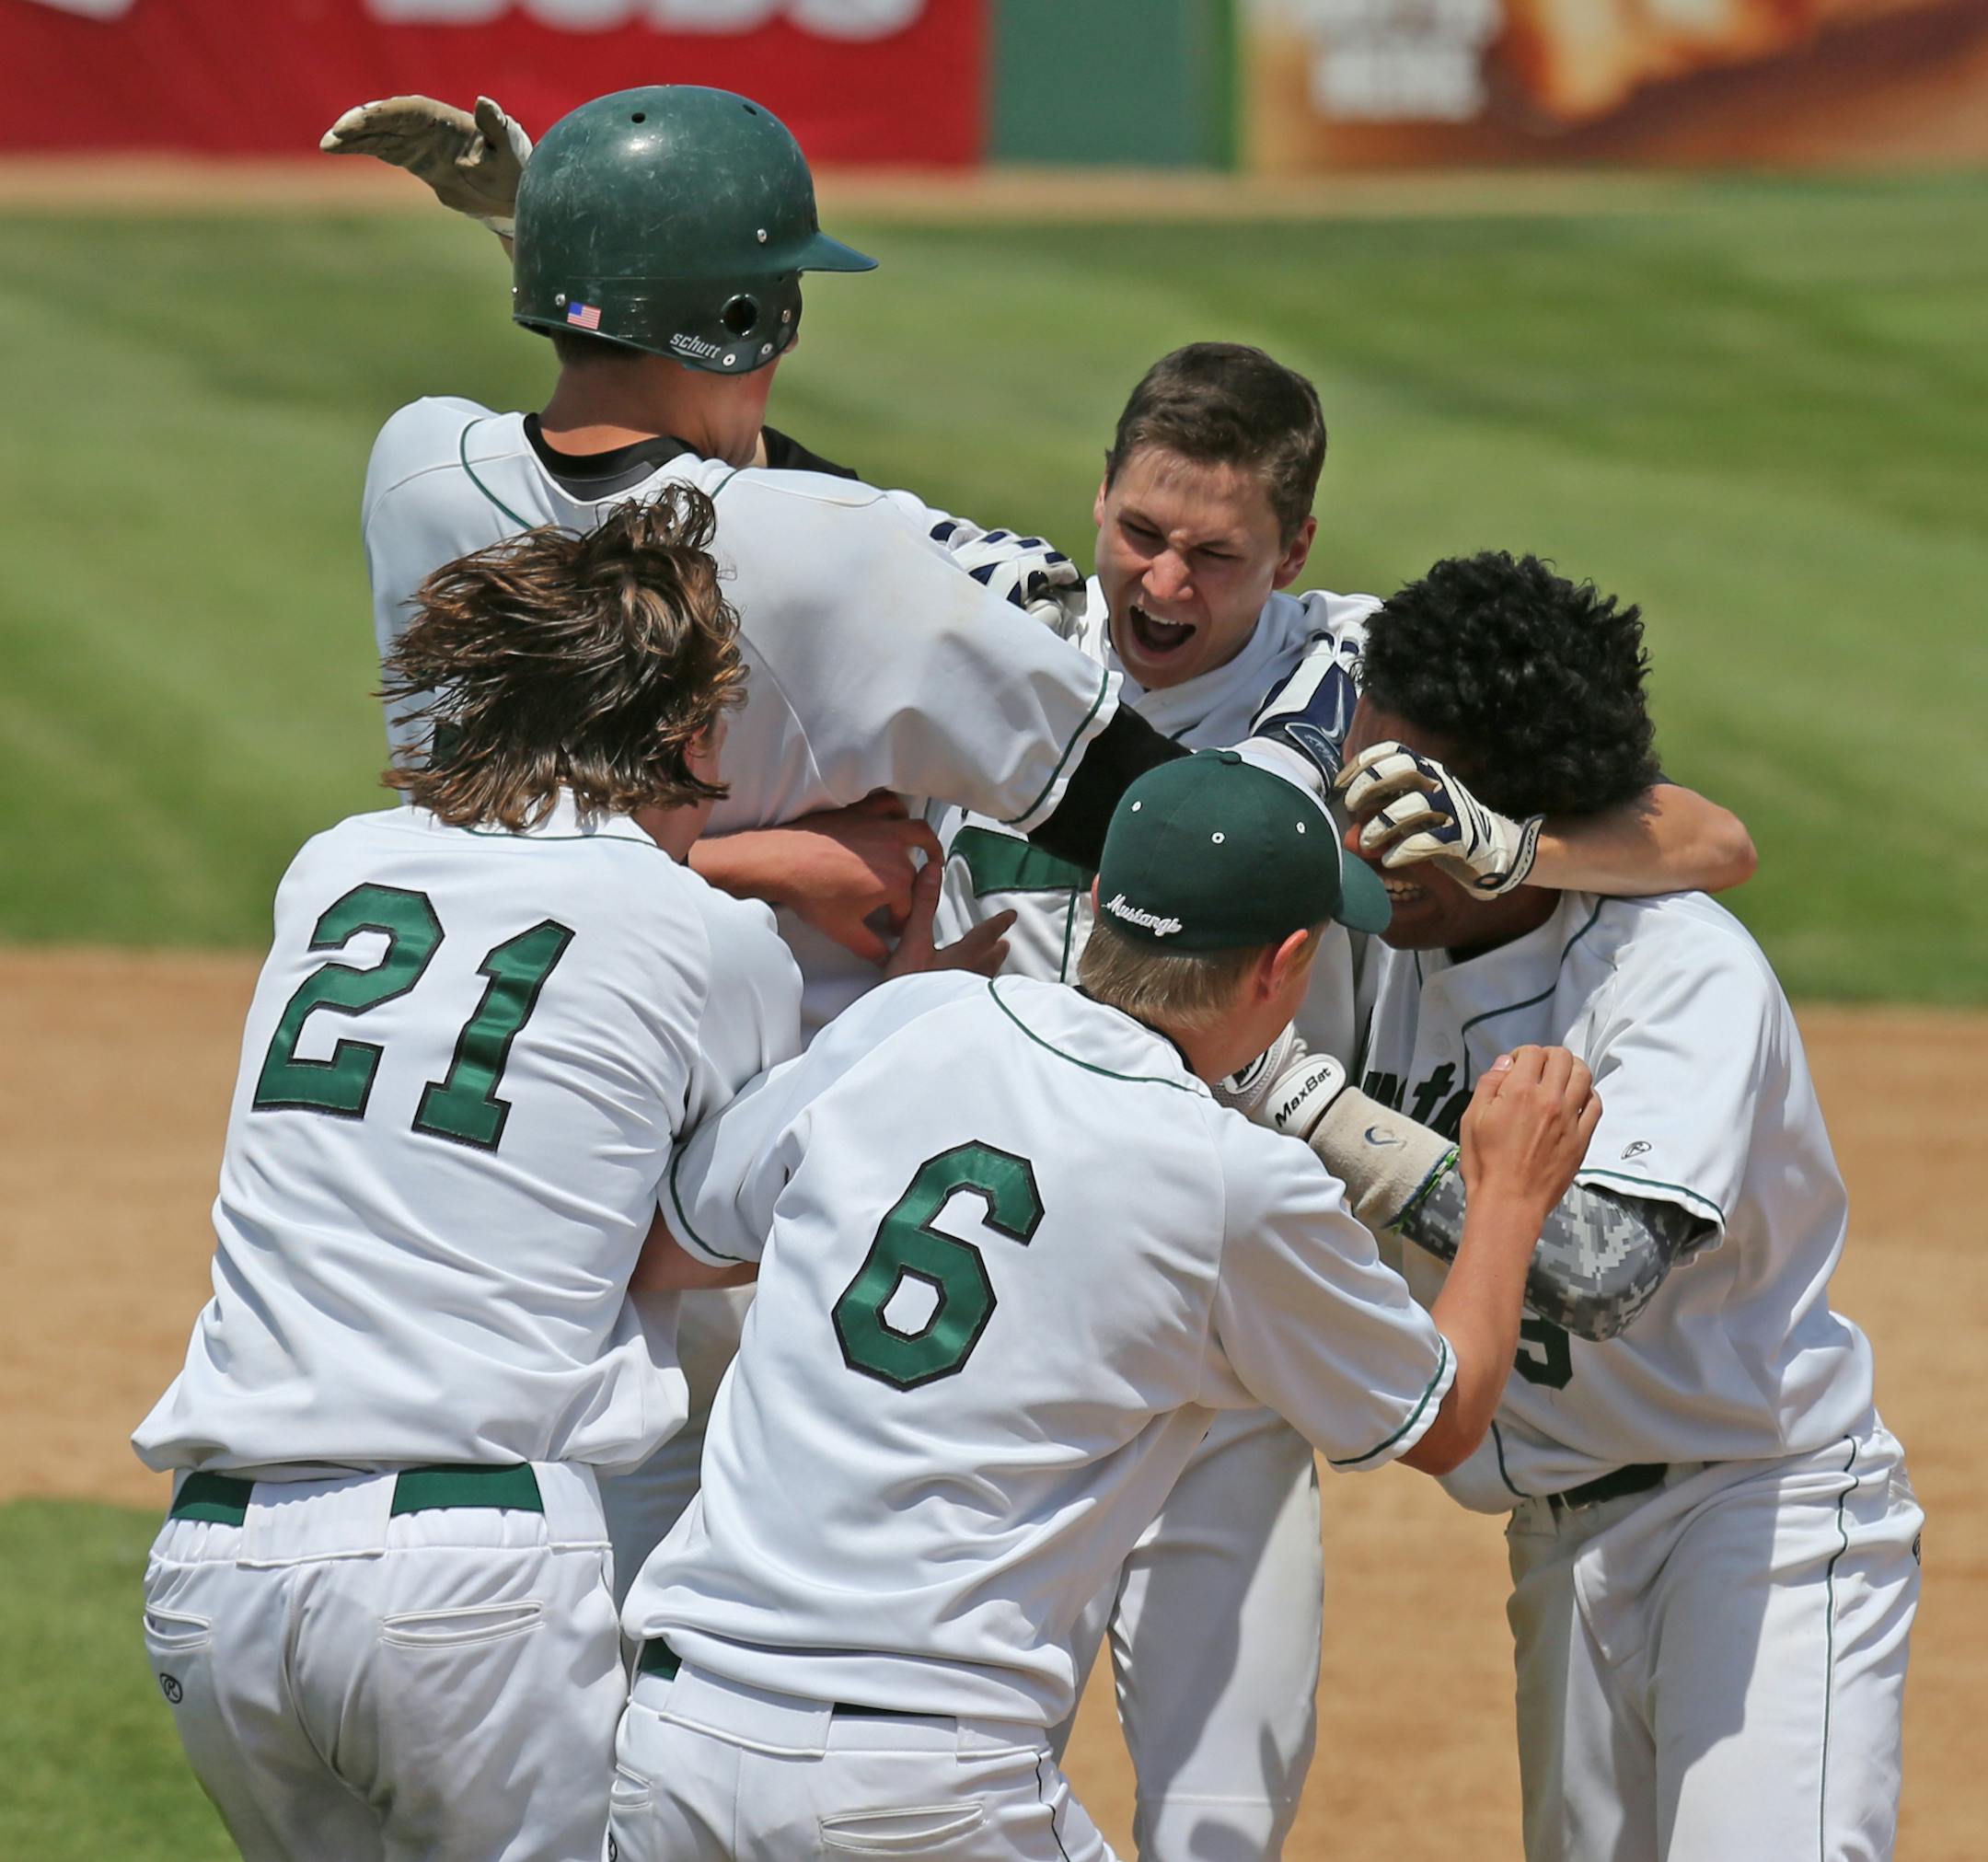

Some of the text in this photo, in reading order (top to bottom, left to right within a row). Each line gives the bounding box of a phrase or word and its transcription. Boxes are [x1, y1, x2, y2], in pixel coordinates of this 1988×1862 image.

[1103, 894, 1183, 937] Mustangs
[252, 882, 576, 1155] 21
[1275, 1067, 1332, 1128] MaxBat
[831, 1139, 1046, 1394] 6
